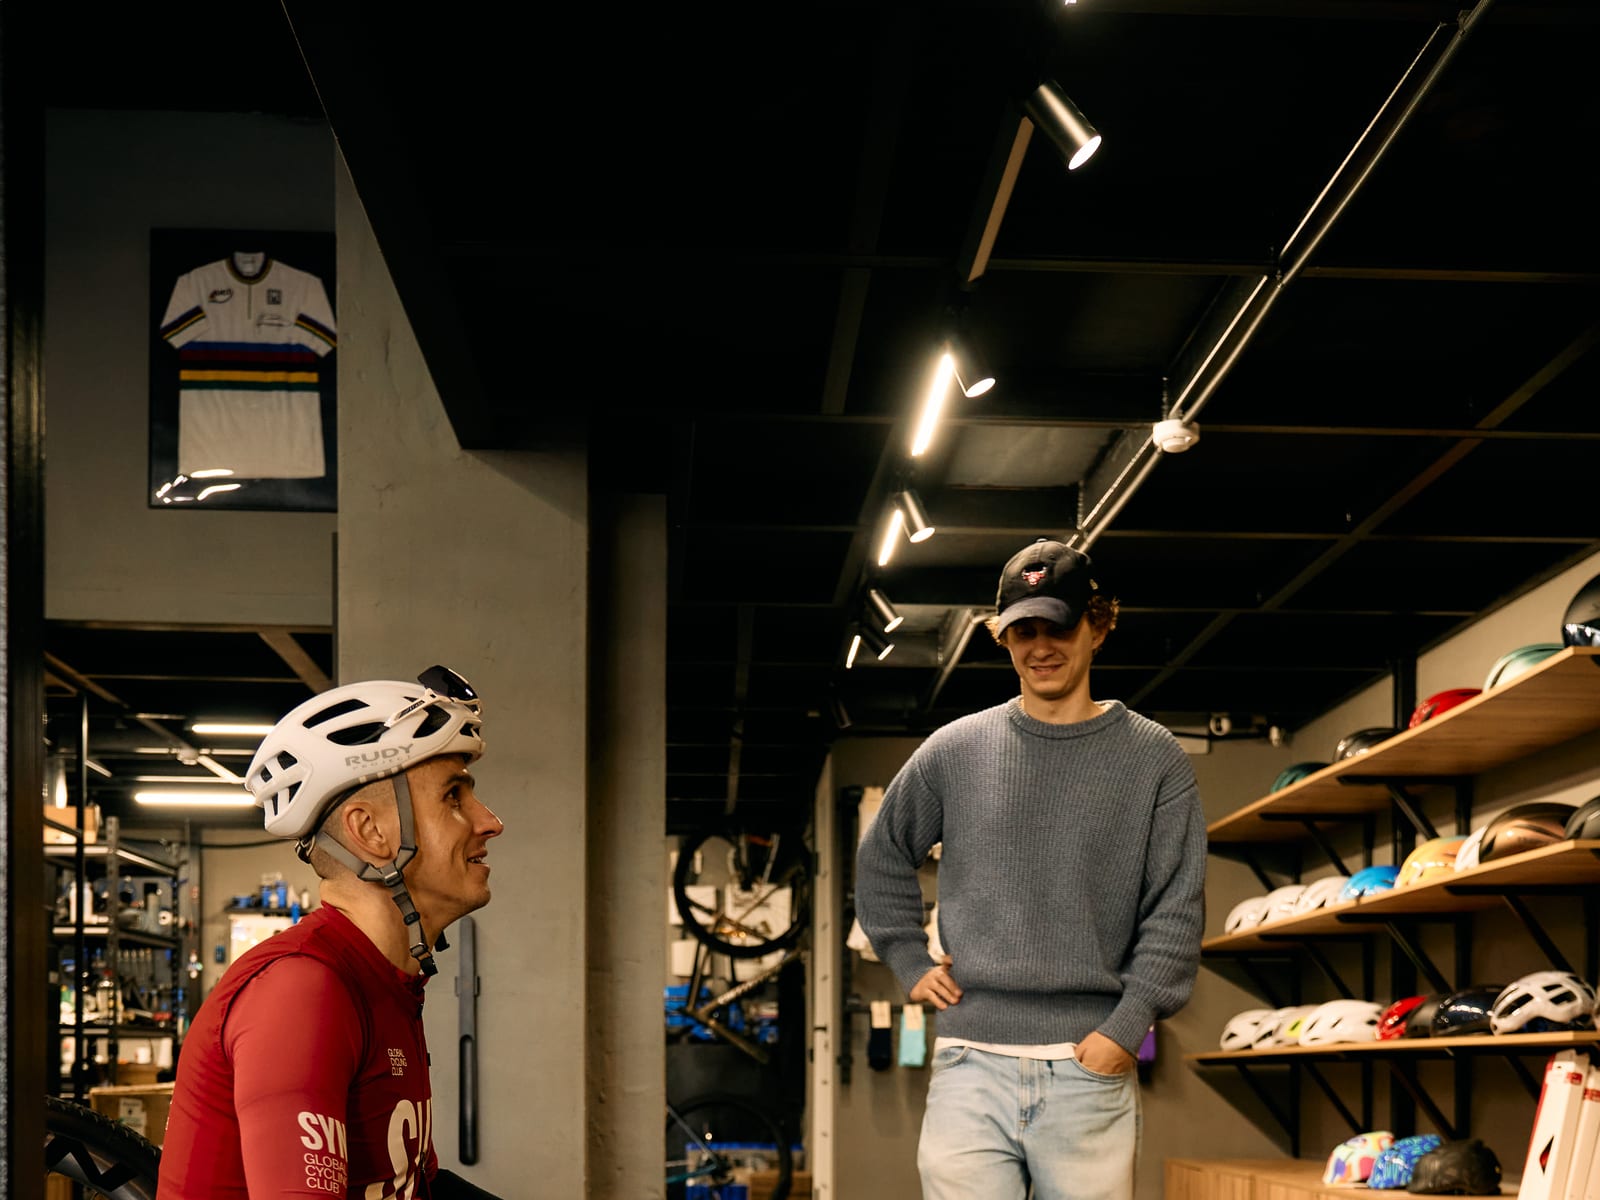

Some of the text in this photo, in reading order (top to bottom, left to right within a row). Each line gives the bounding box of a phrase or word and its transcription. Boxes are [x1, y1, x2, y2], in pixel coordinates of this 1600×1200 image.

[344, 743, 414, 767] RUDY
[303, 1152, 347, 1177] GLOBA
[305, 1164, 348, 1189] CYCLIN
[306, 1176, 340, 1194] CLUB
